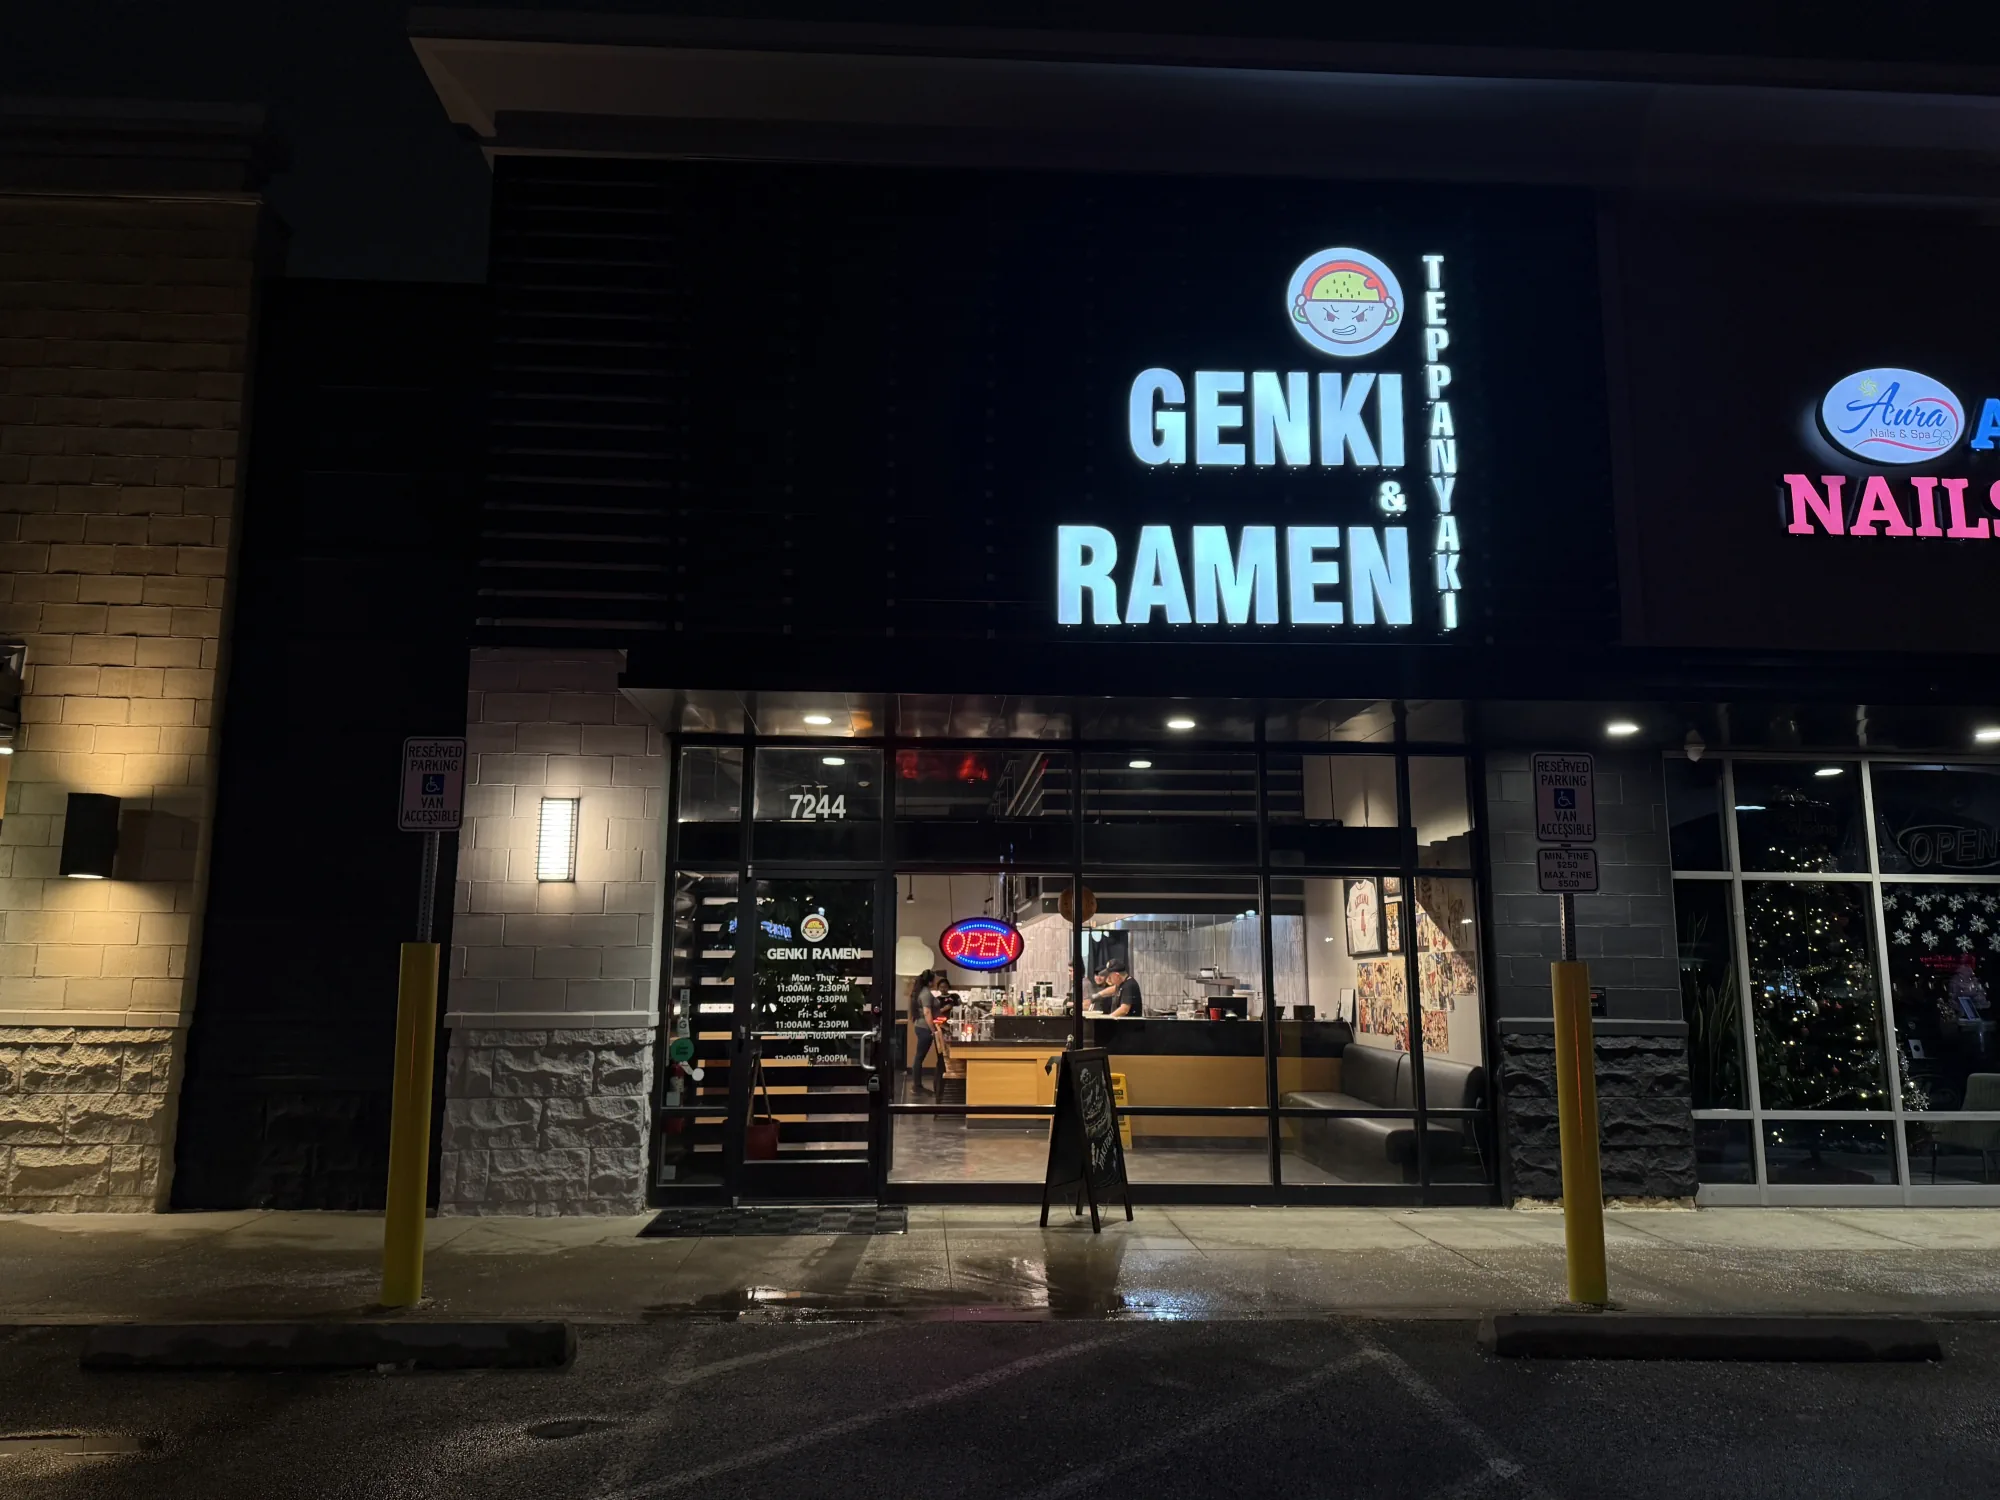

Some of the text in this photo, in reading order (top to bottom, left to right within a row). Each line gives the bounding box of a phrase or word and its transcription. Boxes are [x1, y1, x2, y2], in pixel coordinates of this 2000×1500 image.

[1837, 382, 1948, 434] Aura
[1129, 368, 1405, 467] GENKI
[1870, 428, 1931, 440] Nails & Spa
[1422, 255, 1462, 629] TEPPANYAKI
[1380, 481, 1407, 512] &
[1058, 525, 1413, 625] RAMEN
[408, 746, 463, 757] RESERVED
[411, 760, 458, 771] PARKING
[1537, 761, 1589, 773] RESERVED
[1541, 775, 1587, 786] PARKING
[421, 797, 445, 808] VAN
[789, 794, 847, 819] 7244
[403, 810, 459, 822] ACCESSIBLE
[1554, 811, 1577, 822] VAN
[1540, 824, 1592, 835] ACCESSIBLE
[1544, 852, 1589, 860] MIN. FINE
[1557, 861, 1578, 869] $250
[1544, 871, 1592, 879] MAX. FINE
[945, 930, 1016, 958] OPEN
[767, 948, 861, 960] GENKI RAMEN
[791, 974, 810, 982] Mon
[818, 984, 850, 992] 2:30PM
[816, 995, 848, 1003] 9:30PM
[803, 1045, 820, 1053] Sun
[816, 1054, 848, 1062] 9:00PM
